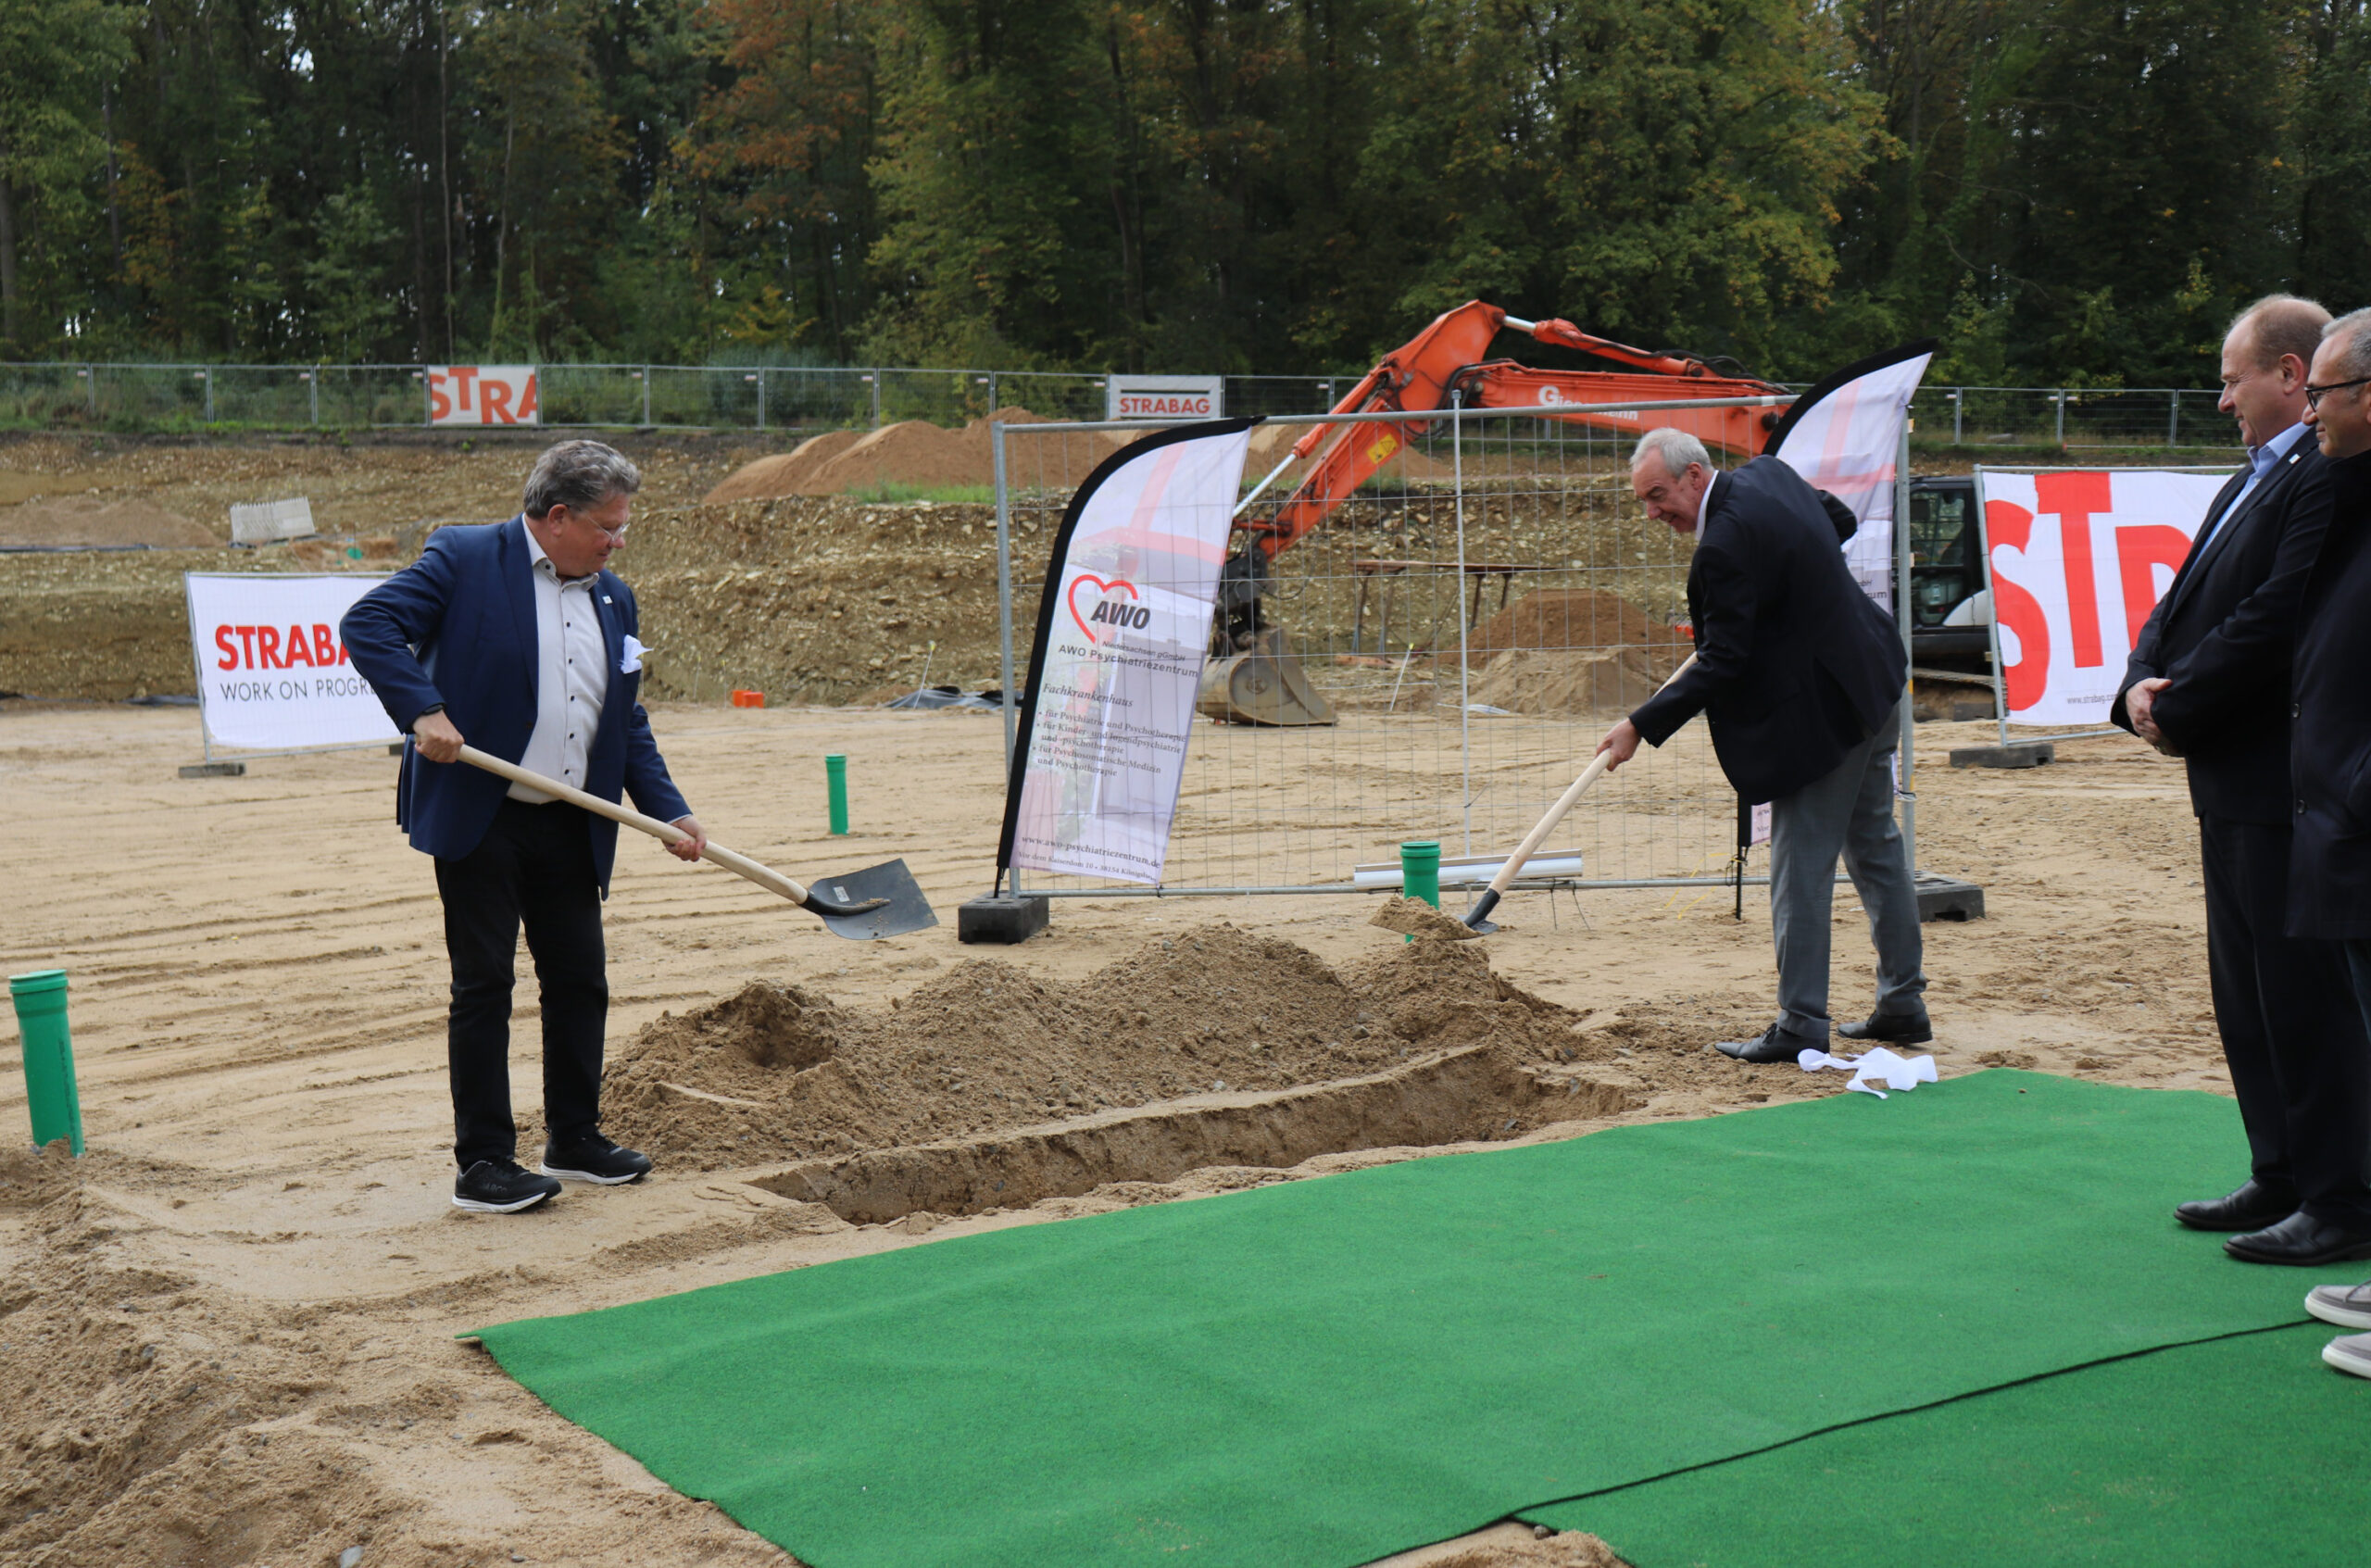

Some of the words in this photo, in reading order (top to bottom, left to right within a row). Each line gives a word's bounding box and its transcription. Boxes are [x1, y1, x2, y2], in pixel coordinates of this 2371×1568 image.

[1120, 397, 1211, 414] STRABAG
[1090, 600, 1151, 630] AWO
[1059, 645, 1086, 657] AWO
[1089, 649, 1199, 678] Psychiatriezentrum
[1102, 640, 1156, 657] Niedersachsen
[1157, 651, 1186, 661] gGmbH
[220, 683, 274, 702] WORK
[279, 681, 307, 700] ON
[317, 677, 376, 697] PROGR
[1043, 683, 1134, 708] Fachkrankenhaus
[2066, 694, 2118, 705] www.strabag.co
[1041, 734, 1058, 743] und
[1043, 721, 1056, 730] für
[1091, 730, 1108, 739] und
[1110, 731, 1182, 754] Jugendpsychiatrie
[1045, 709, 1059, 719] für
[1060, 711, 1105, 726] Psychiatrie
[1106, 721, 1123, 730] und
[1124, 723, 1186, 743] Psychotherapie
[1037, 757, 1054, 767] und
[1055, 759, 1118, 777] Psychotherapie
[1038, 745, 1052, 754] für
[1054, 746, 1128, 767] Psychosomatische
[1129, 759, 1161, 774] Medizin
[1022, 836, 1160, 869] www.awo-psychiatriezentrum.de
